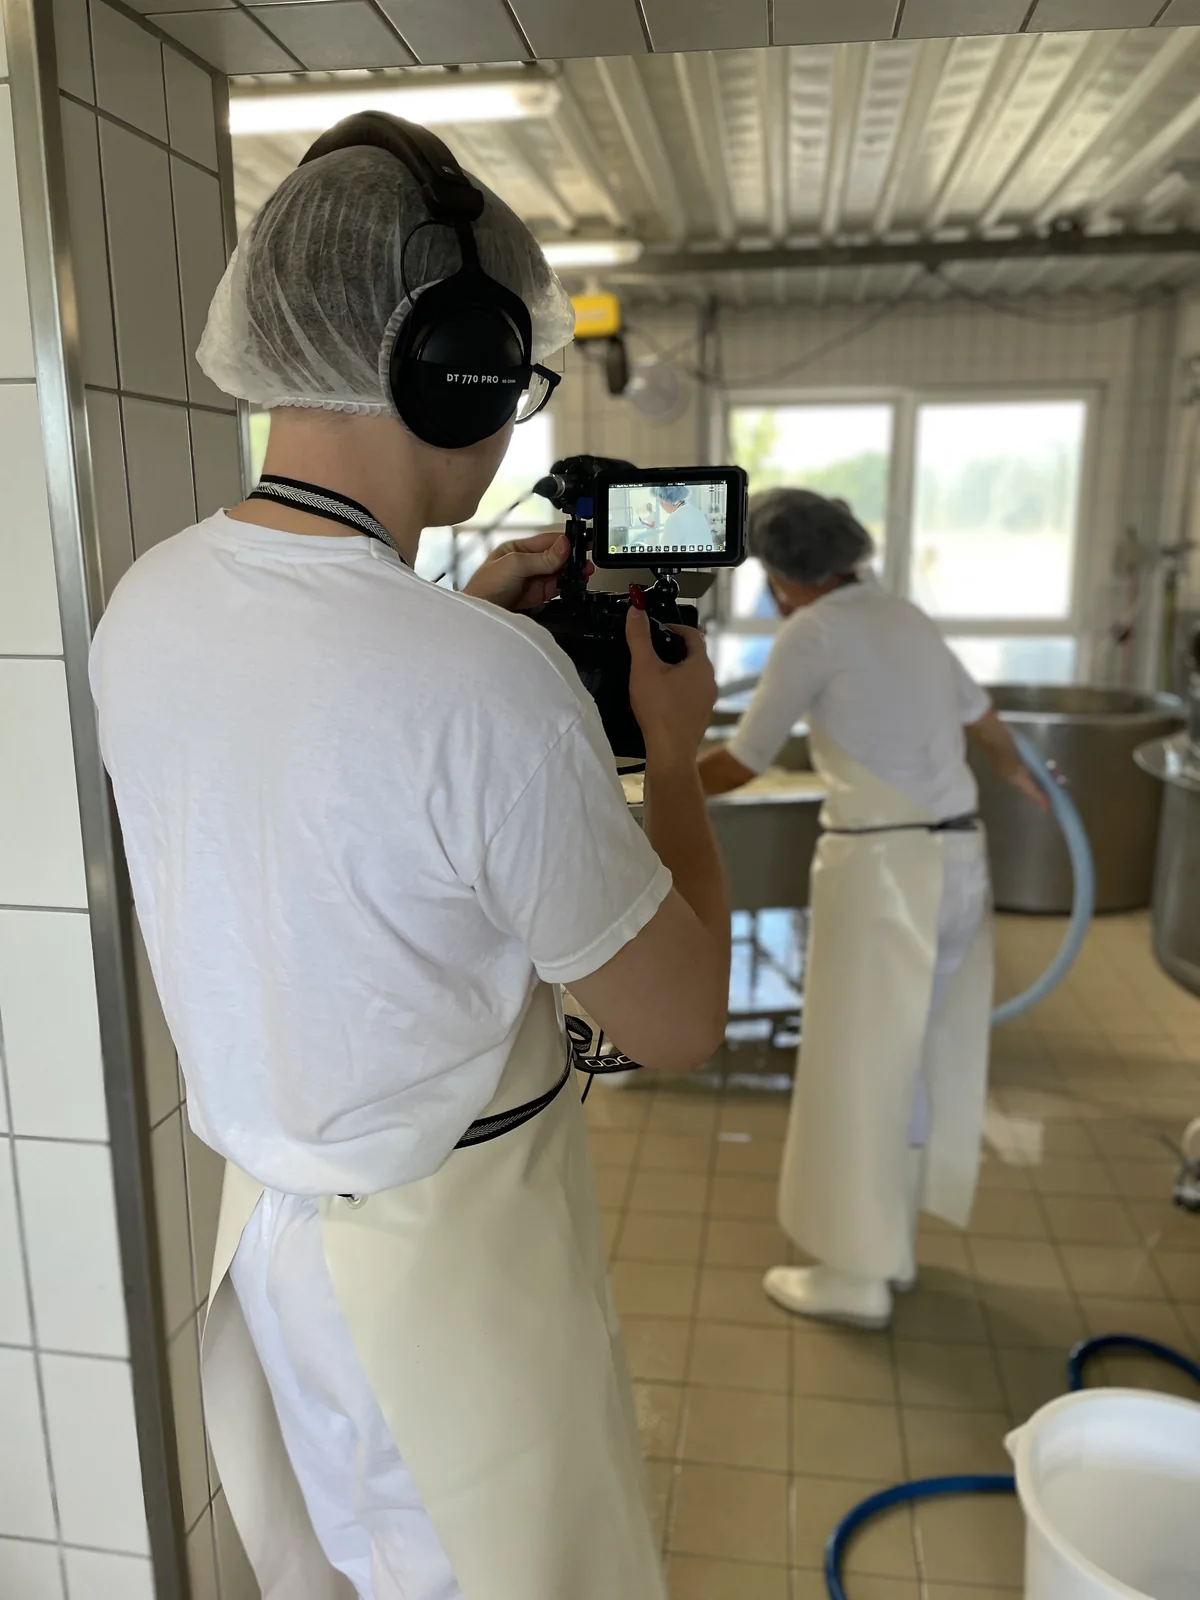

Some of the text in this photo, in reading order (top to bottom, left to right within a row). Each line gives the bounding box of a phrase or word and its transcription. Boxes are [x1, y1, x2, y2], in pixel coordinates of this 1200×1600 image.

[447, 373, 459, 382] DT
[462, 374, 478, 384] 770
[481, 375, 499, 384] PRO
